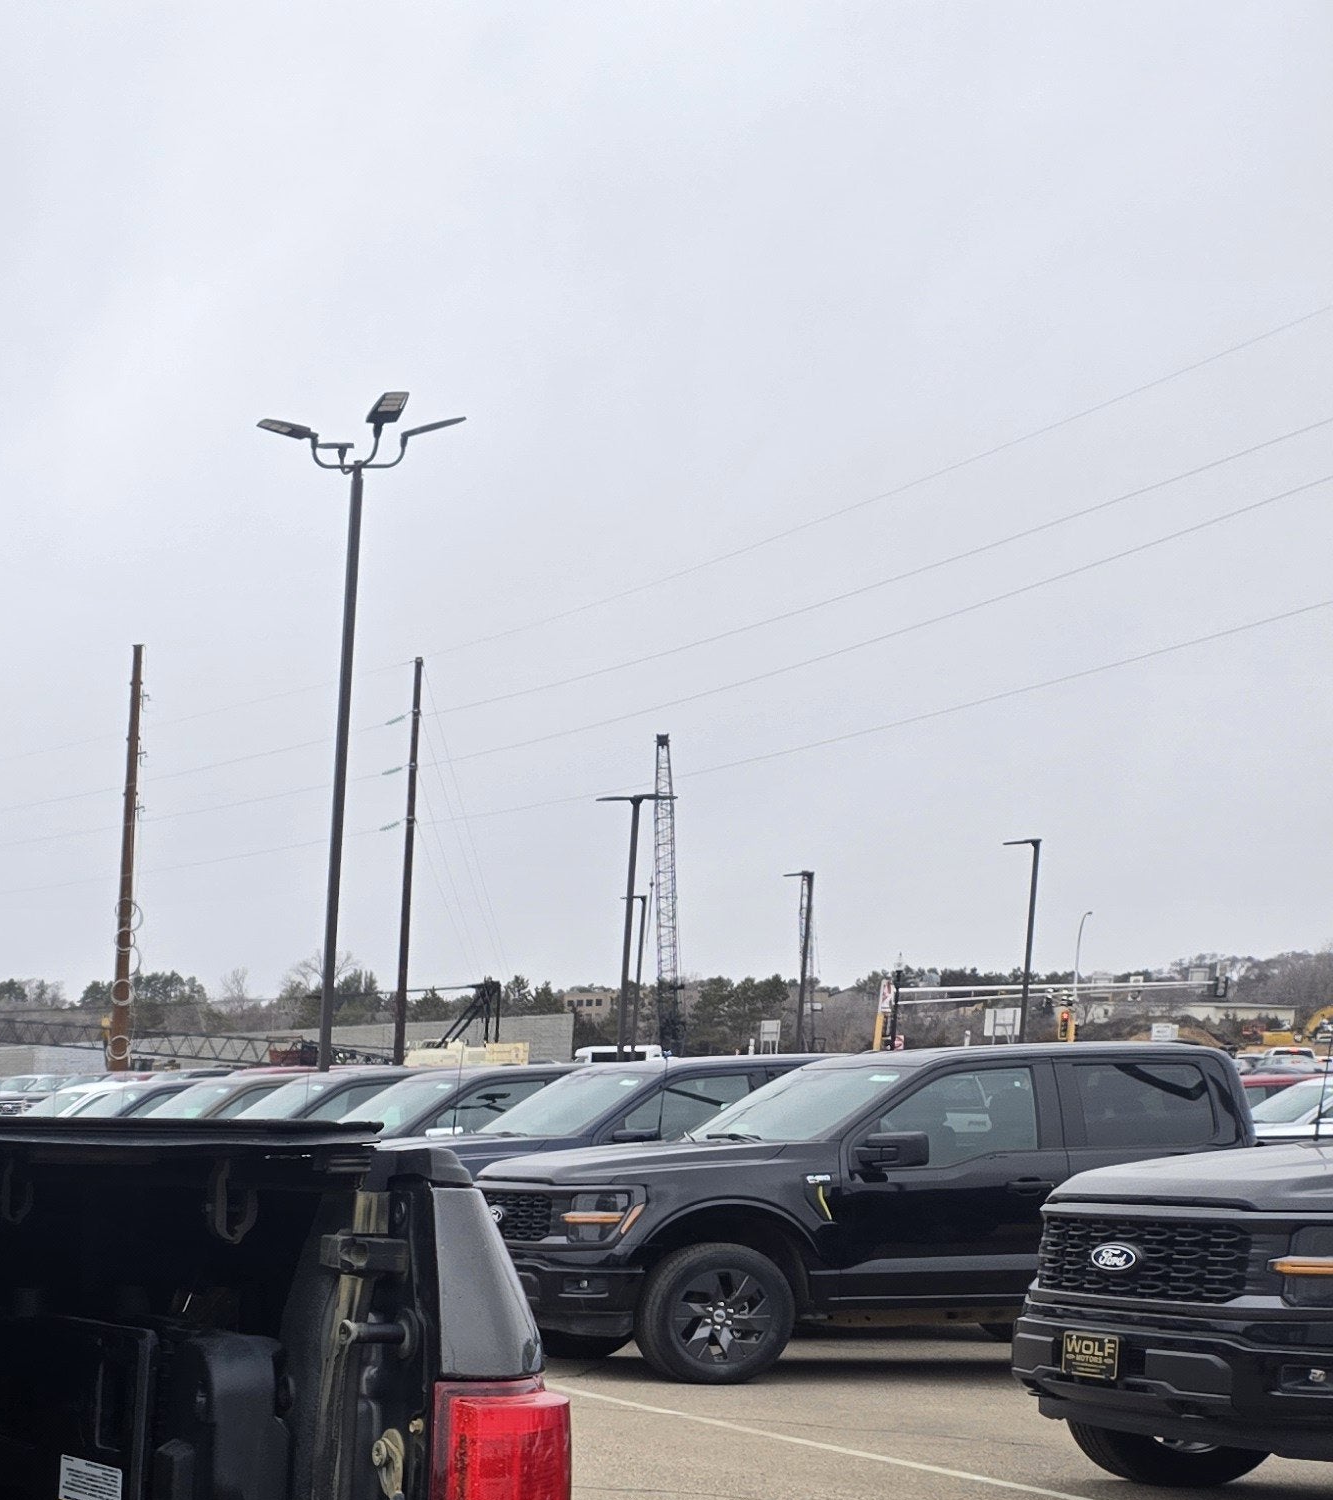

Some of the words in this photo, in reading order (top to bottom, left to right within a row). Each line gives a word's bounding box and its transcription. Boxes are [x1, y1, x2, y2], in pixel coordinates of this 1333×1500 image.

[1098, 1248, 1127, 1267] Ford
[1066, 1337, 1116, 1357] WOLF
[1075, 1354, 1103, 1364] MOTORS
